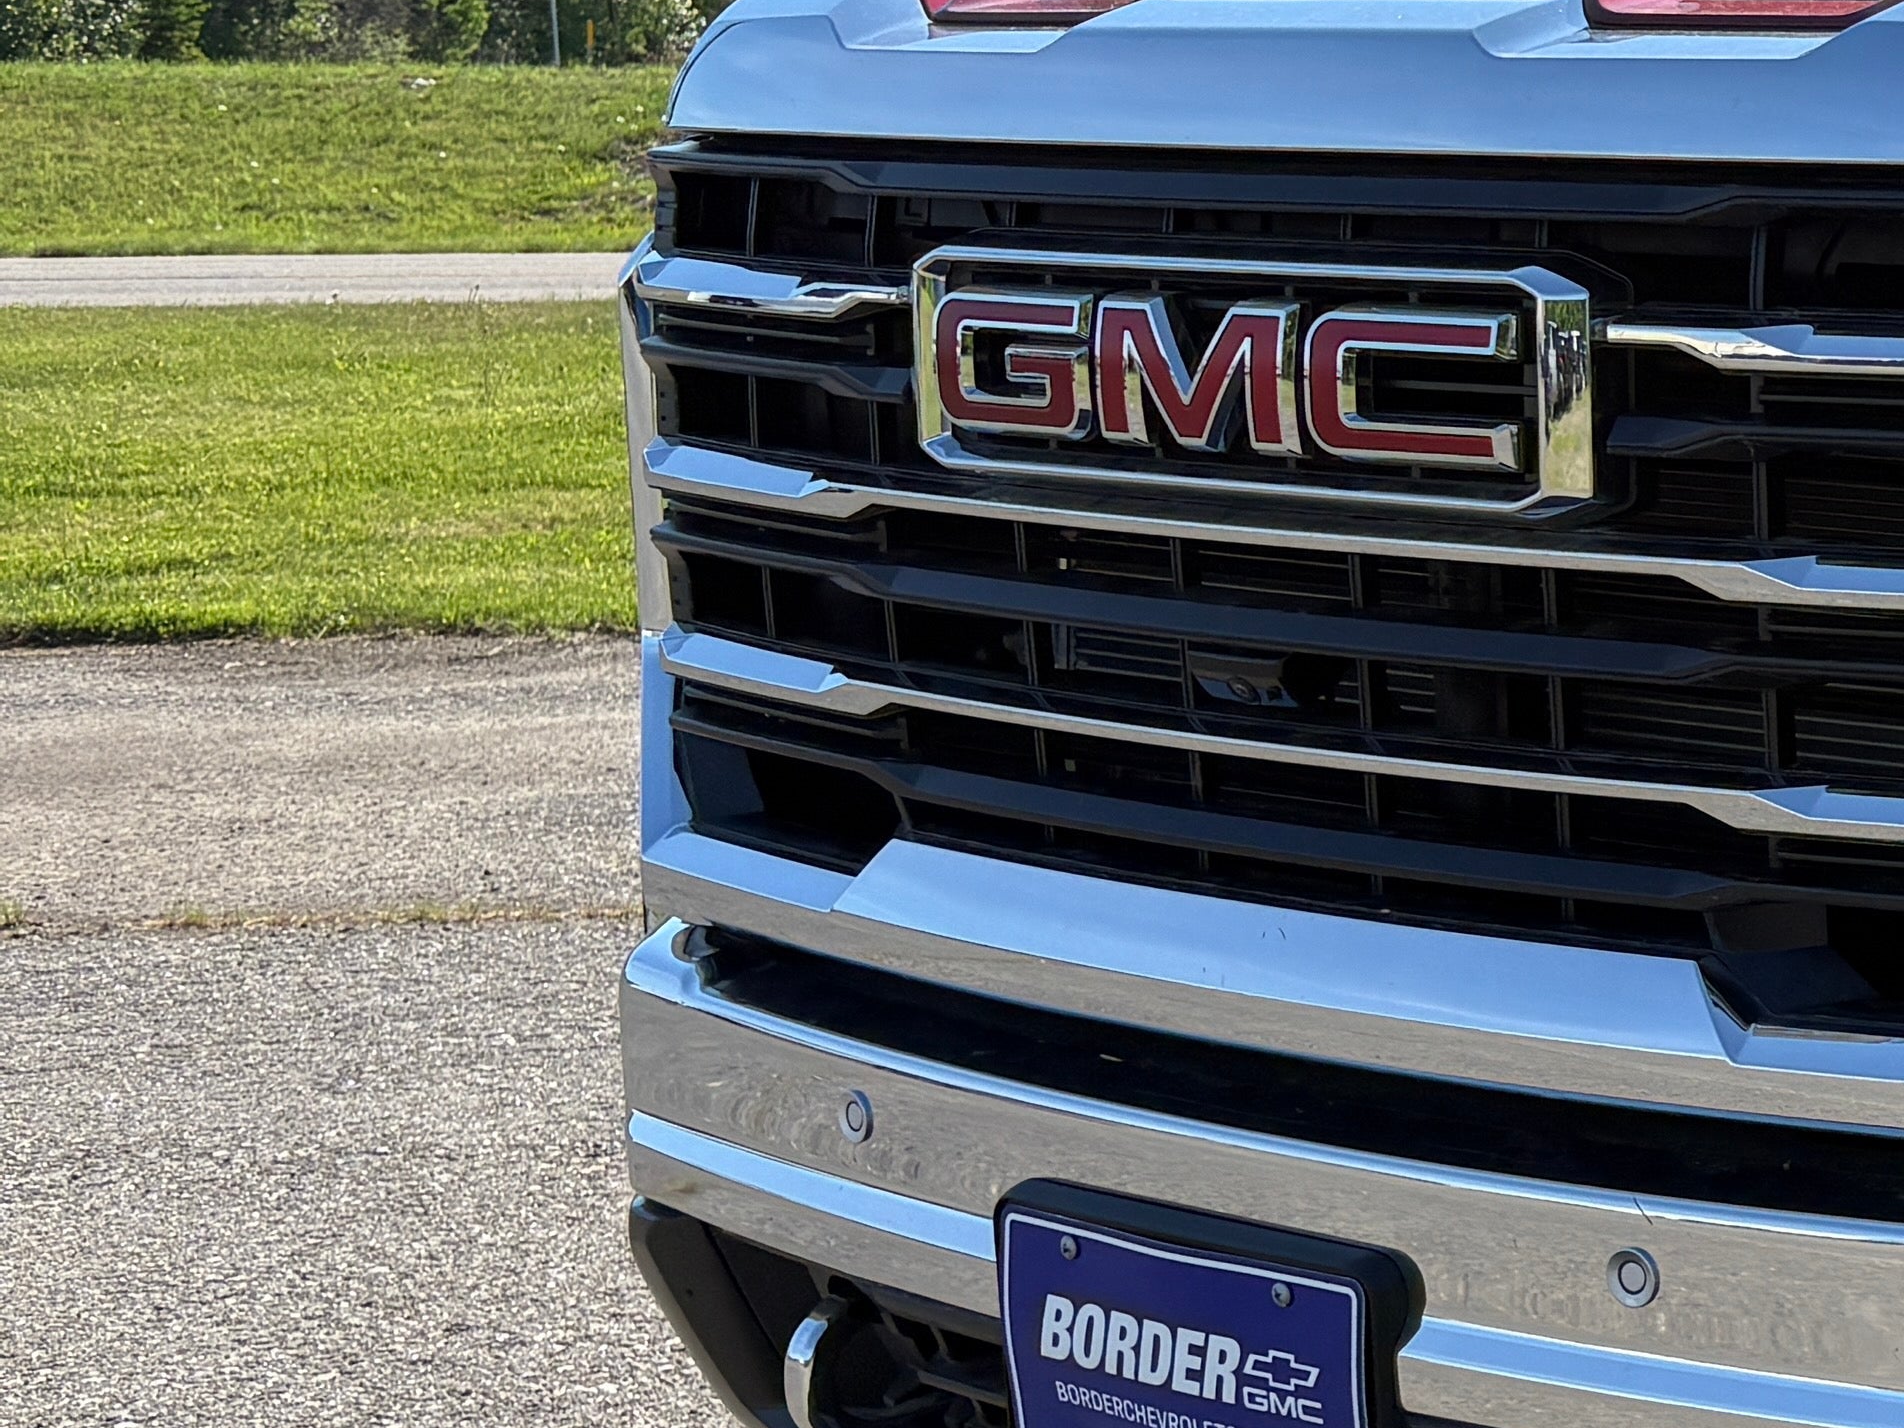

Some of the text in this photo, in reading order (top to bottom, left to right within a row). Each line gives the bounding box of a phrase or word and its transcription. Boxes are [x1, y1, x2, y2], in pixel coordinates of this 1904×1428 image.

[935, 291, 1518, 472] GMC
[1040, 1293, 1242, 1404] BORDER
[1243, 1386, 1325, 1425] GMC
